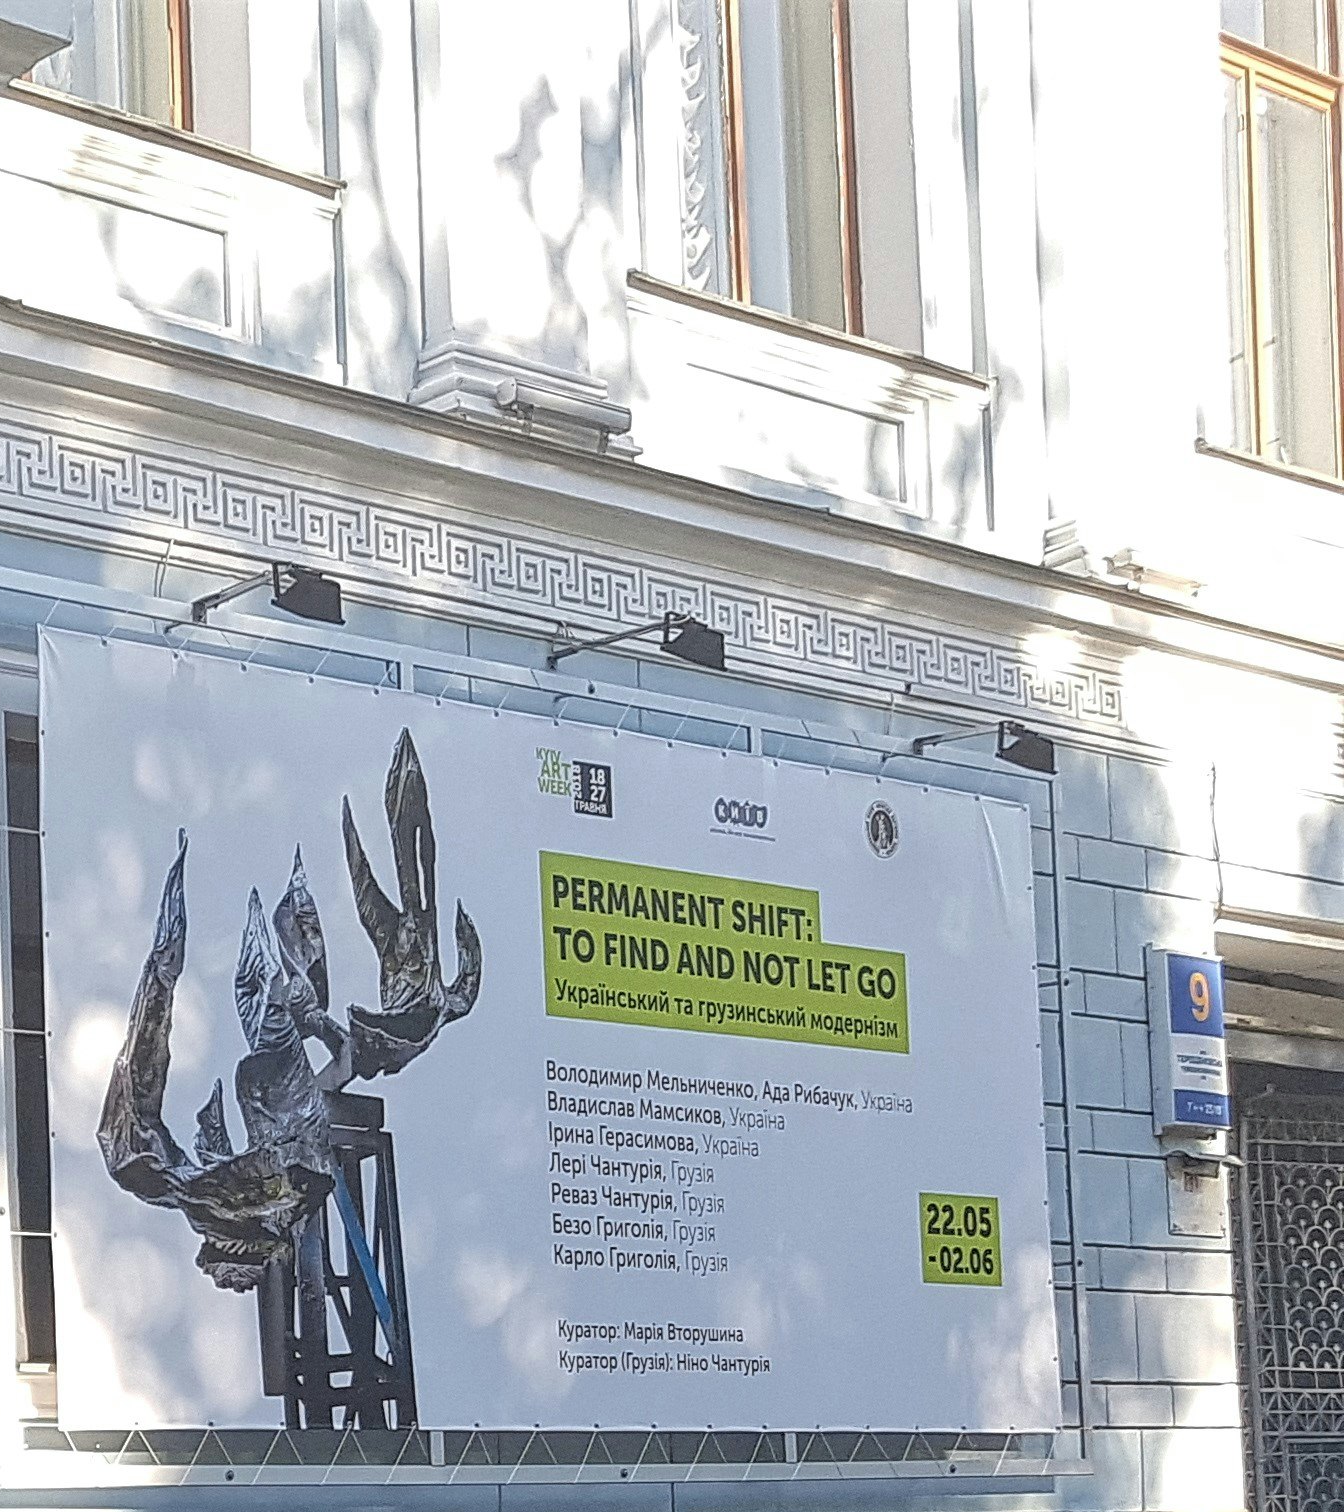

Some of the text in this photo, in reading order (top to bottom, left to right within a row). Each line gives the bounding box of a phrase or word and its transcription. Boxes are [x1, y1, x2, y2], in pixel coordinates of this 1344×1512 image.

[536, 747, 561, 761] KYIV
[541, 760, 571, 780] ART
[537, 777, 572, 797] WEEK
[589, 768, 605, 785] 18
[574, 800, 607, 814] ТРАВНЯ
[590, 785, 606, 802] 27
[552, 874, 814, 942] PERMANENT SHIFT:
[552, 926, 896, 1001] TO FIND AND NOT LET GO
[554, 978, 898, 1039] Український та грузинський модернізм
[1190, 971, 1210, 1022] 9
[547, 1060, 913, 1114] Володимир Мельниченко, Ада Рибачук, Україна
[548, 1092, 785, 1131] Владислав Мамсиков, Україна
[549, 1122, 759, 1158] Ірина Герасимова, Україна
[549, 1153, 713, 1185] Лері Чантурія, Грузія
[551, 1183, 724, 1216] Реваз Чантурія, Грузія
[553, 1212, 715, 1244] Безо Григолія, Грузія
[926, 1203, 992, 1238] 22.05
[554, 1244, 727, 1275] Карло Григолія, Грузія
[558, 1318, 743, 1345] Куратор: Марія Вторушина
[559, 1350, 770, 1375] Куратор (Грузія): Ніно Чантурія
